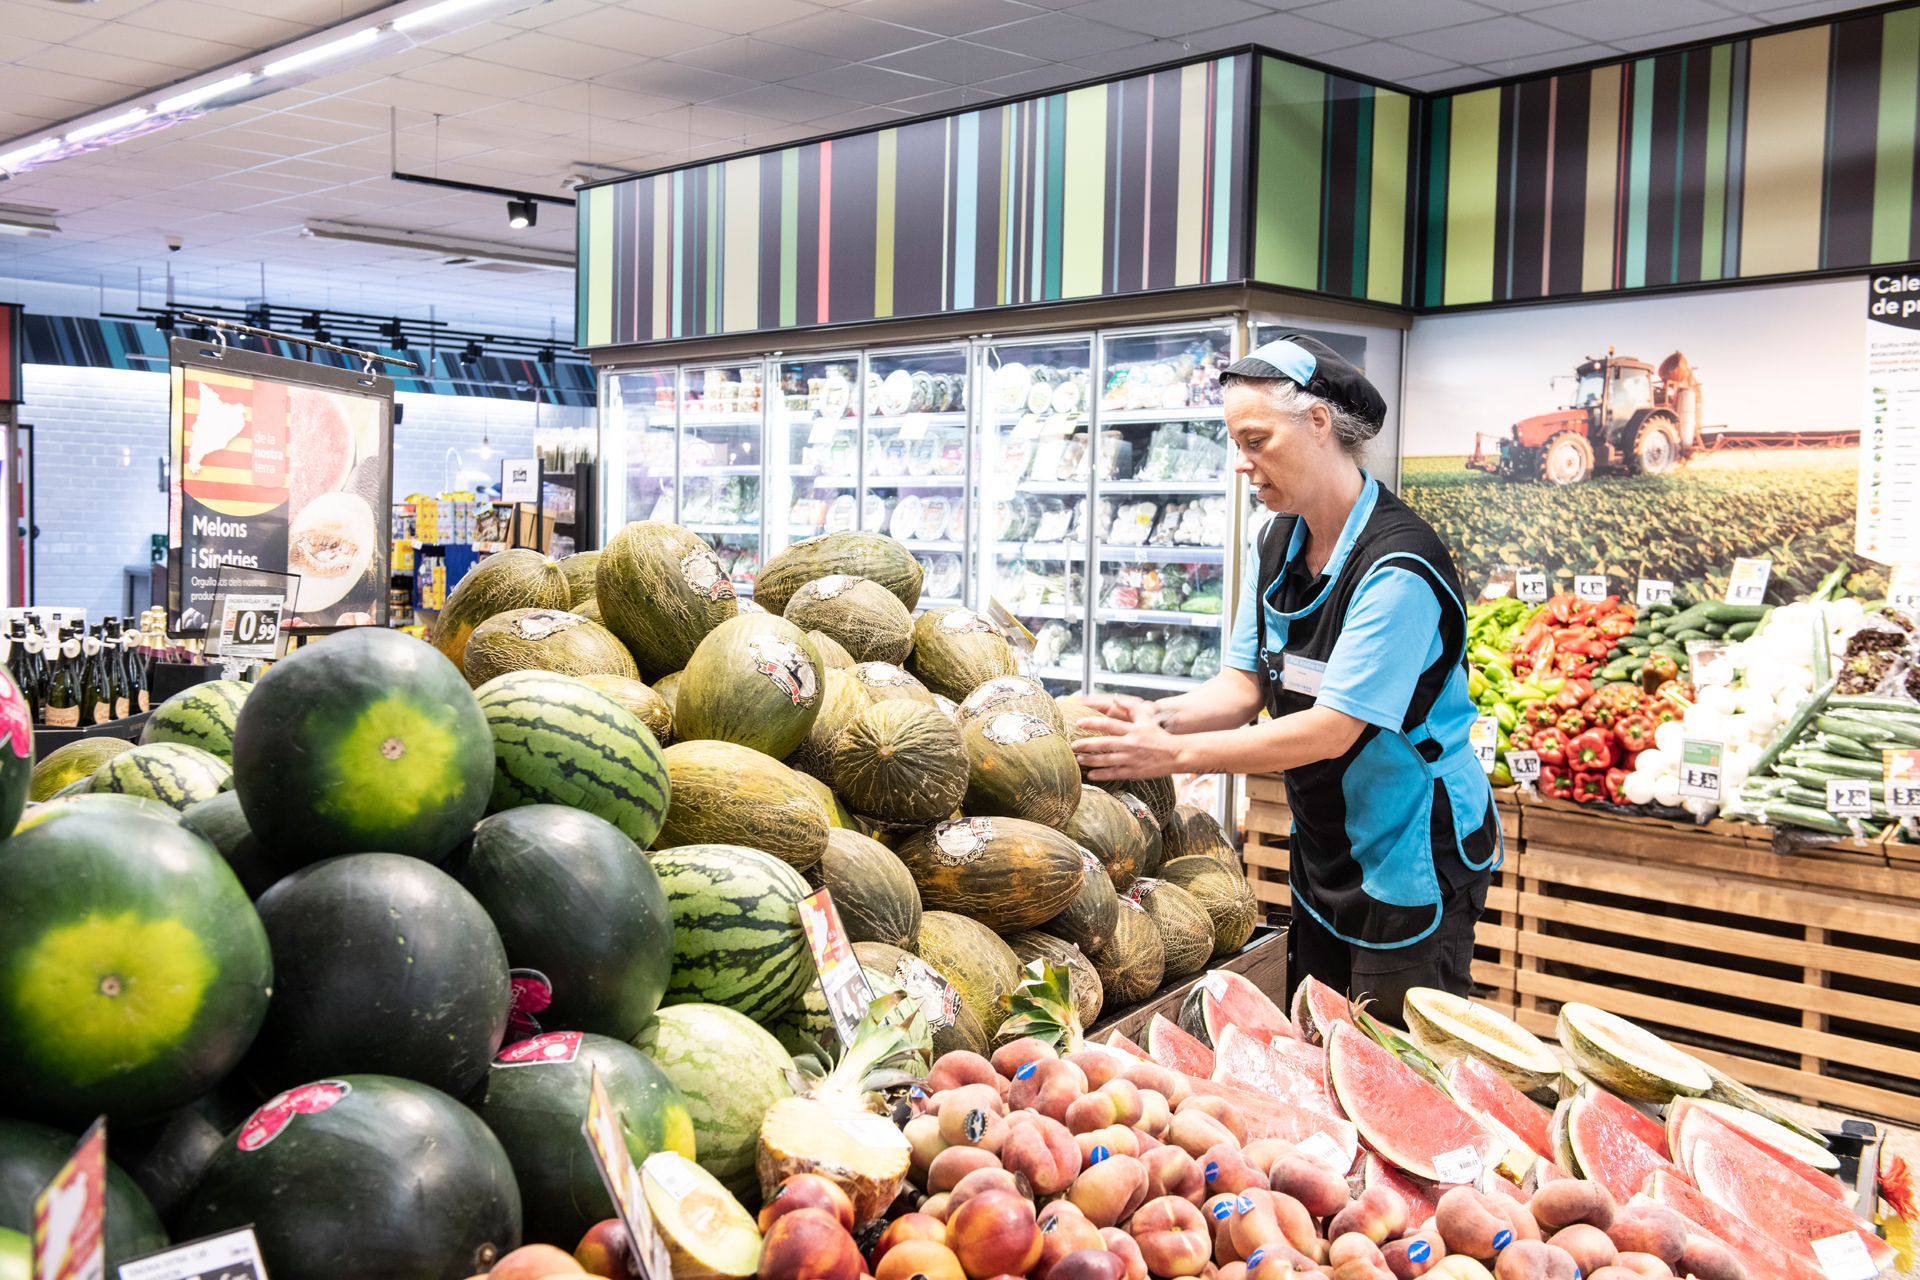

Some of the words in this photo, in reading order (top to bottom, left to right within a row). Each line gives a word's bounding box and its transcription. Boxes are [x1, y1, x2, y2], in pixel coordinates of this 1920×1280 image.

[1871, 297, 1900, 316] de
[254, 431, 266, 444] de
[267, 432, 276, 445] la
[254, 448, 284, 460] nostra
[254, 461, 276, 474] terra
[192, 514, 248, 538] Melons
[191, 548, 197, 569] i
[198, 548, 259, 570] Síndries
[238, 610, 277, 644] 0,99
